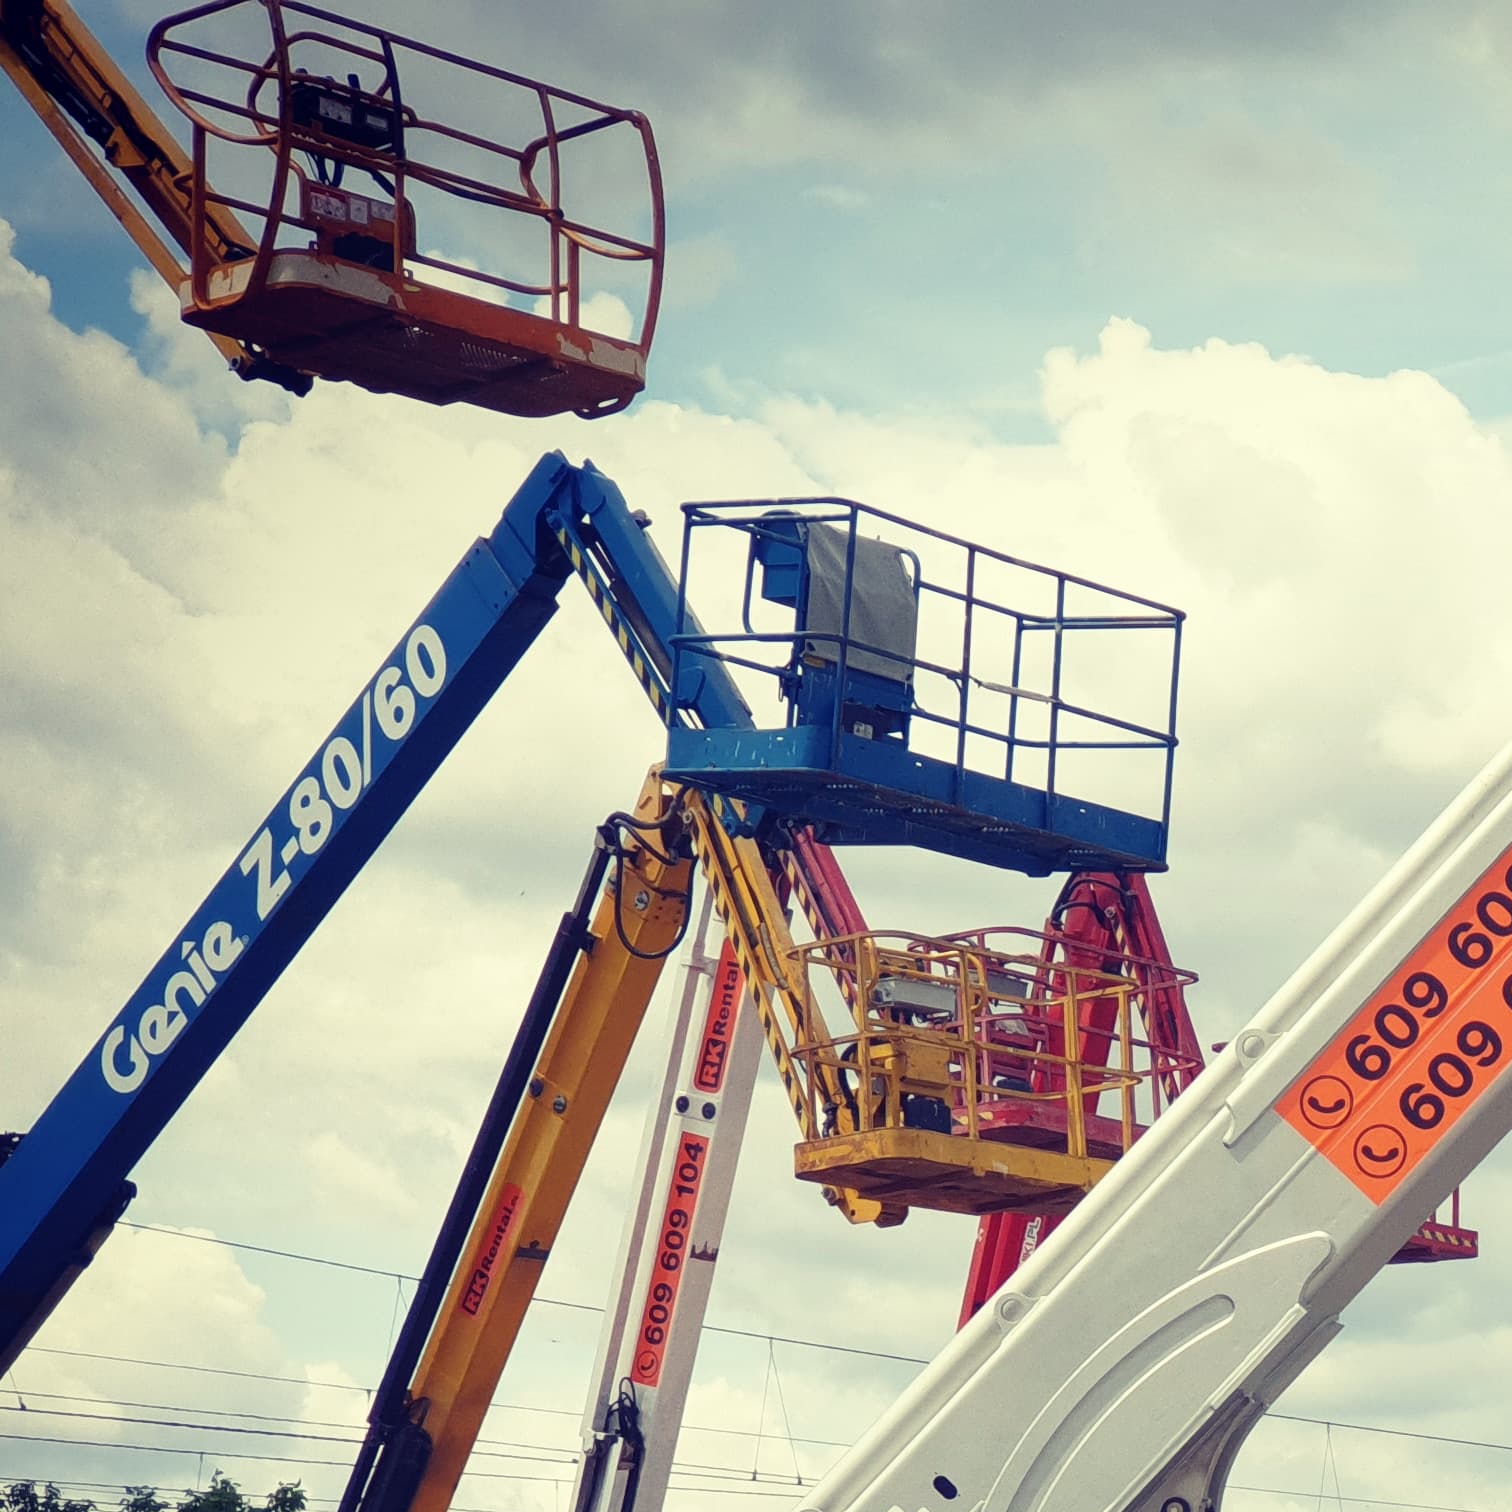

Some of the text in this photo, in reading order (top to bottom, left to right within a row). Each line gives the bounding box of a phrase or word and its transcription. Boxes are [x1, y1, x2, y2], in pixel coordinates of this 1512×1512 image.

[101, 624, 447, 1094] Genie Z-80/60
[701, 1039, 726, 1087] RK
[1345, 971, 1448, 1080] 609
[1399, 1020, 1503, 1130] 609
[463, 1270, 489, 1315] RK
[644, 1141, 704, 1346] 609 609 104
